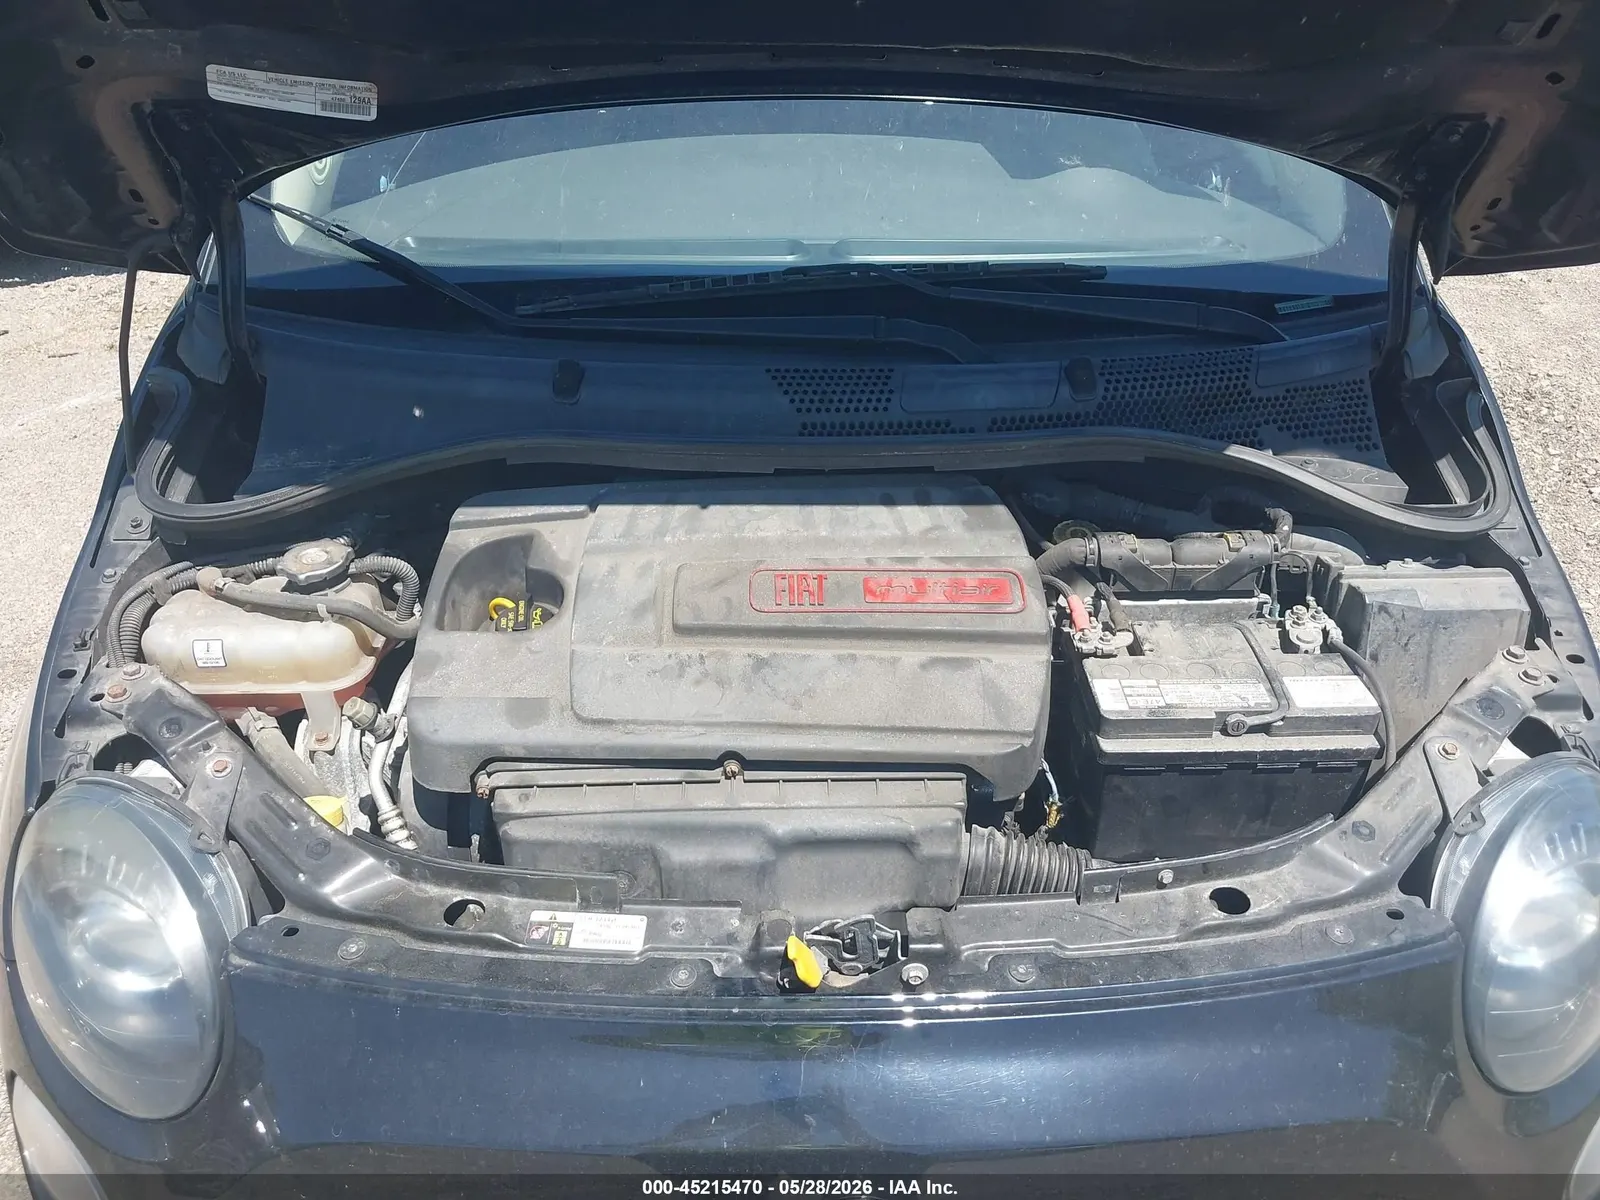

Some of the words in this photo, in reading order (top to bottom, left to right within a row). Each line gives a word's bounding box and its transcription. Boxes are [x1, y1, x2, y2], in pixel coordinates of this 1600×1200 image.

[338, 84, 373, 92] INFORMATION
[349, 96, 372, 105] 129AA
[774, 573, 828, 606] FIAT
